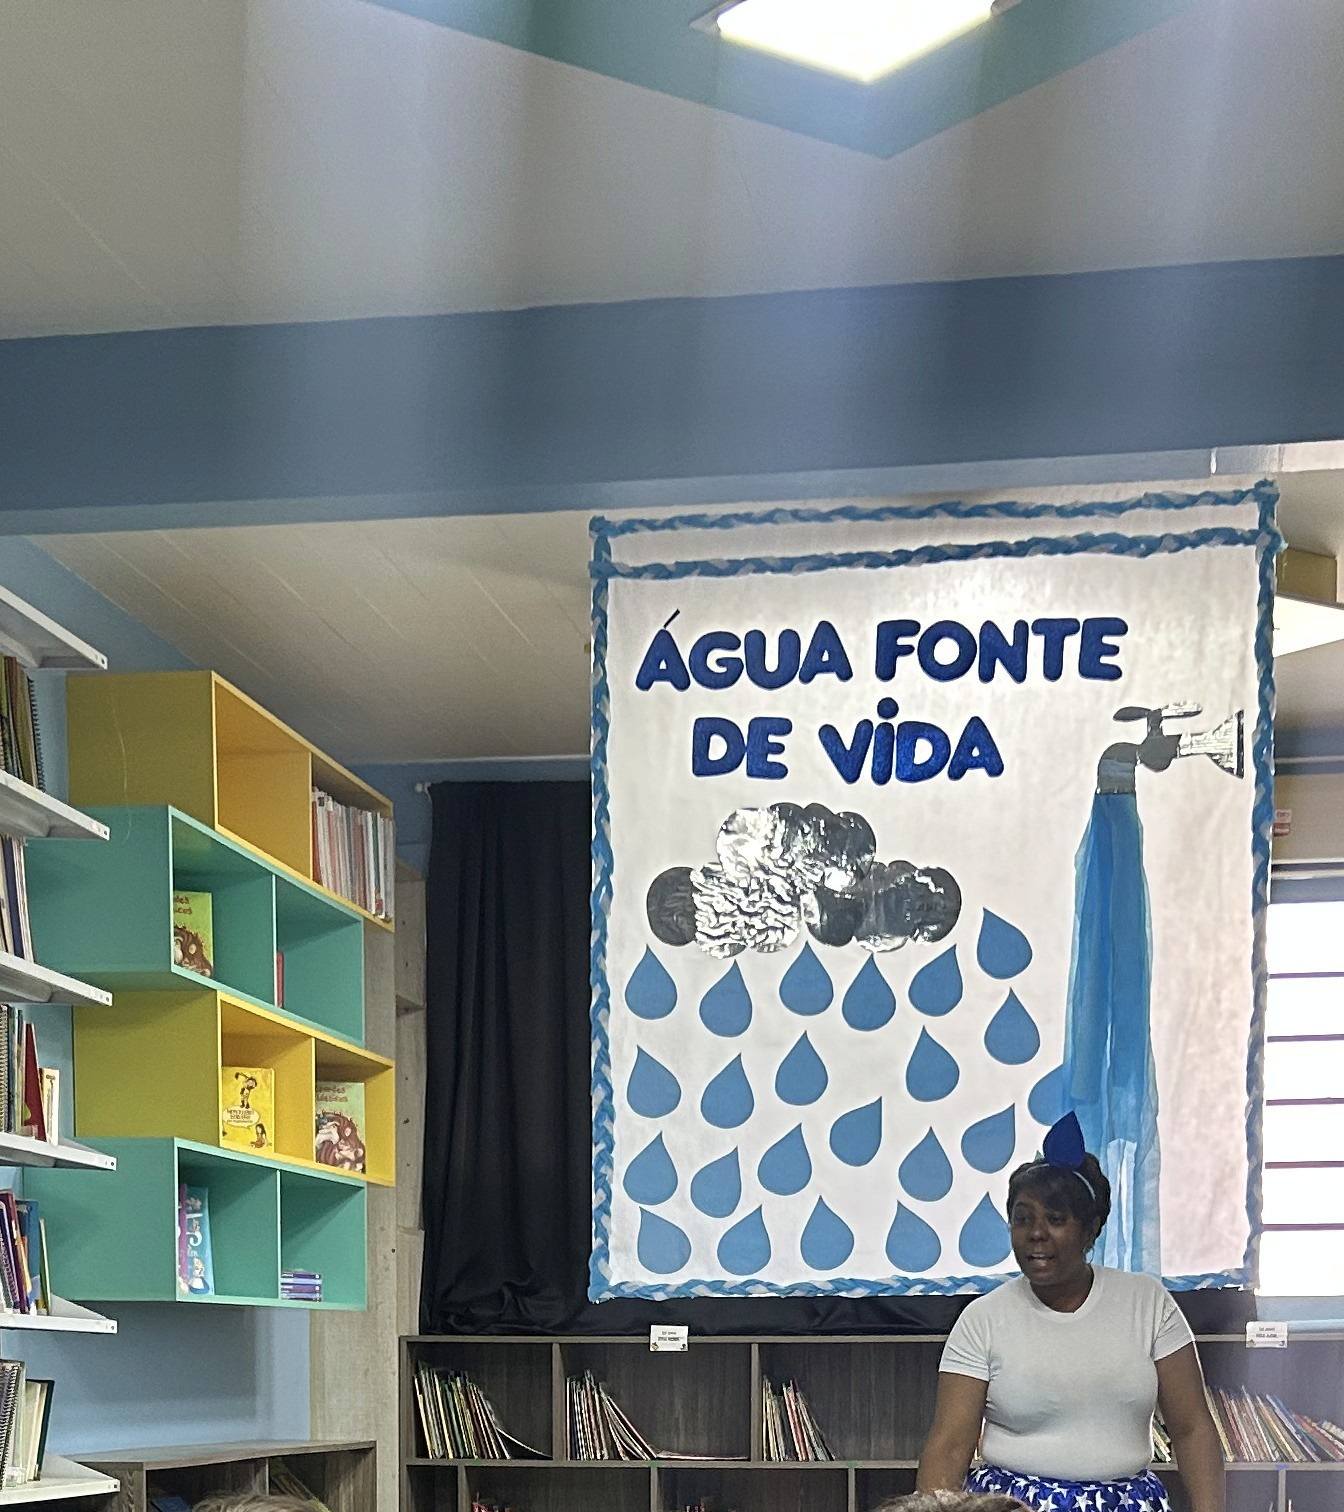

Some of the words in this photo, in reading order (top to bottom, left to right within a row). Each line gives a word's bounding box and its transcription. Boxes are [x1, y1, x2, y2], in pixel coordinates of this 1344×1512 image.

[636, 608, 853, 691] ÁGUA
[875, 617, 1128, 684] FONTE
[692, 717, 792, 779] DE
